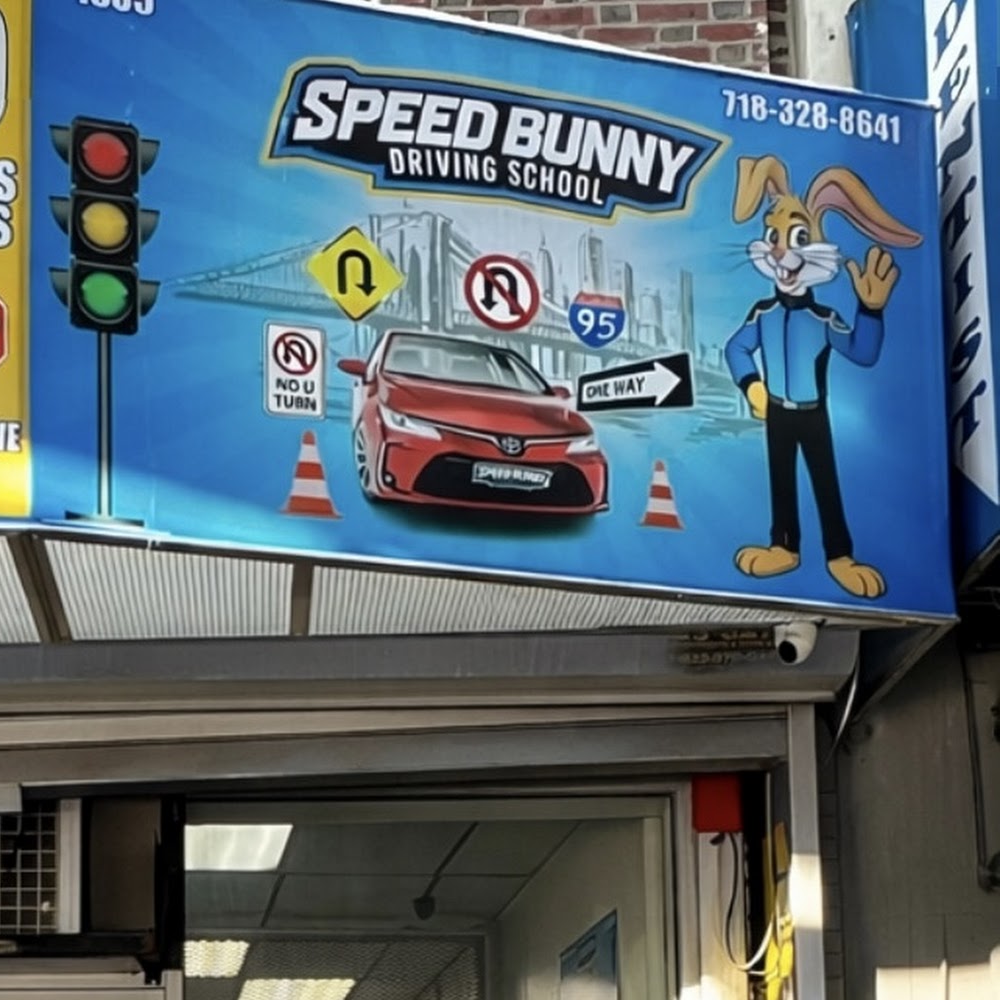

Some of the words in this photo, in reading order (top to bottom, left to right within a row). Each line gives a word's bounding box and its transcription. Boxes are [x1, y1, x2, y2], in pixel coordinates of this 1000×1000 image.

[292, 78, 499, 151] SPEED
[501, 106, 696, 194] BUNNY
[722, 89, 900, 145] 718-328-8641
[389, 147, 498, 183] DRIVING
[507, 159, 604, 206] SCHOOL
[577, 308, 617, 340] 95
[303, 380, 315, 395] U
[613, 376, 646, 396] WAY
